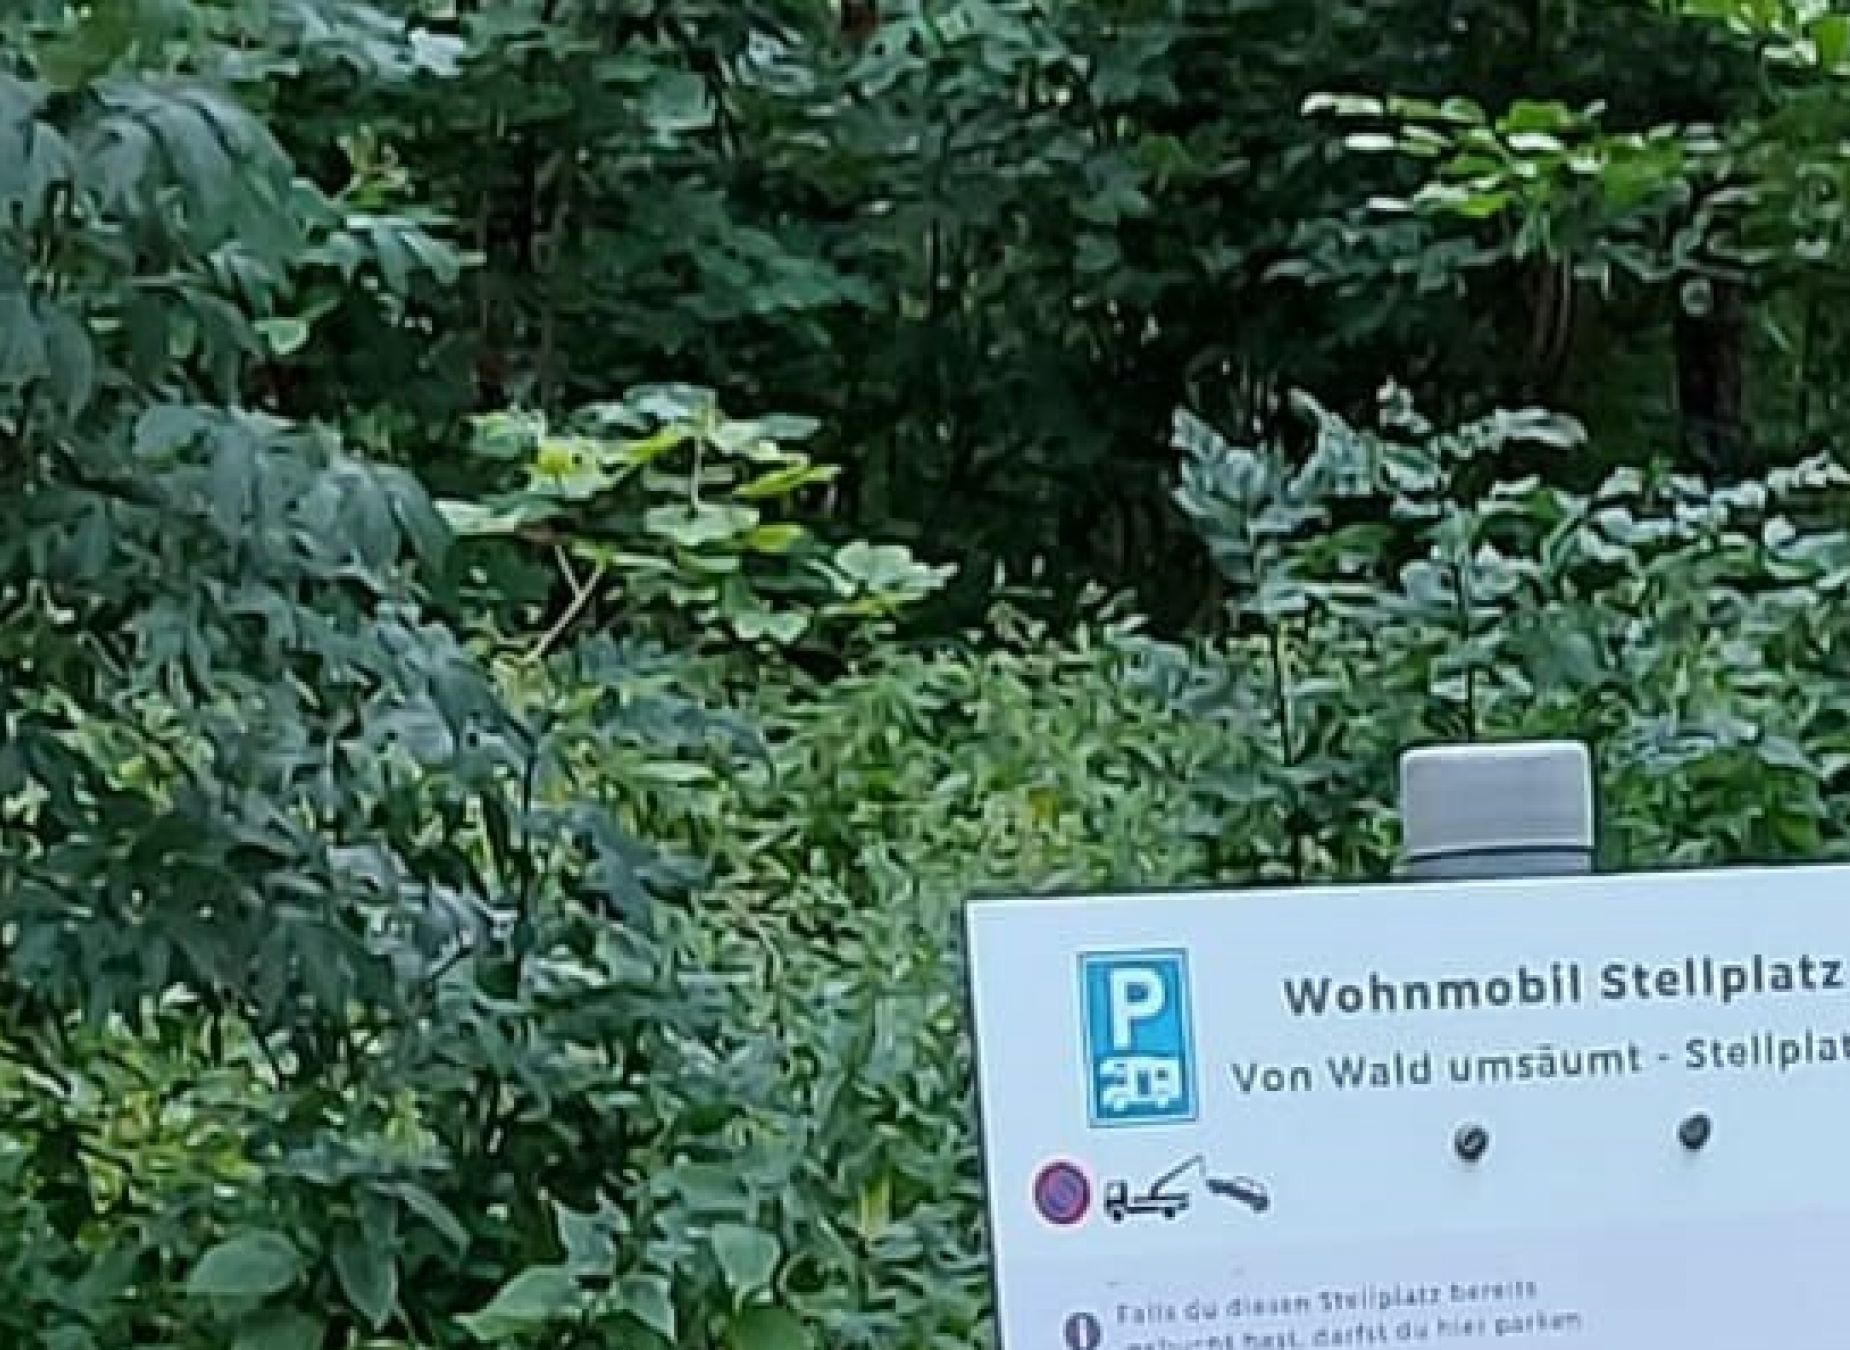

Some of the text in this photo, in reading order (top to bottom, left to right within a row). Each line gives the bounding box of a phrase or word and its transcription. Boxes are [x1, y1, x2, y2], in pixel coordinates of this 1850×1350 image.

[1110, 968, 1165, 1049] P
[1283, 953, 1844, 1015] Wohnmobil Stellplatz
[1232, 1061, 1311, 1092] Von
[1326, 1050, 1431, 1087] Wald
[1450, 1043, 1641, 1081] umsäumt
[1186, 1297, 1217, 1320] du
[1318, 1283, 1441, 1313] Stellplatz
